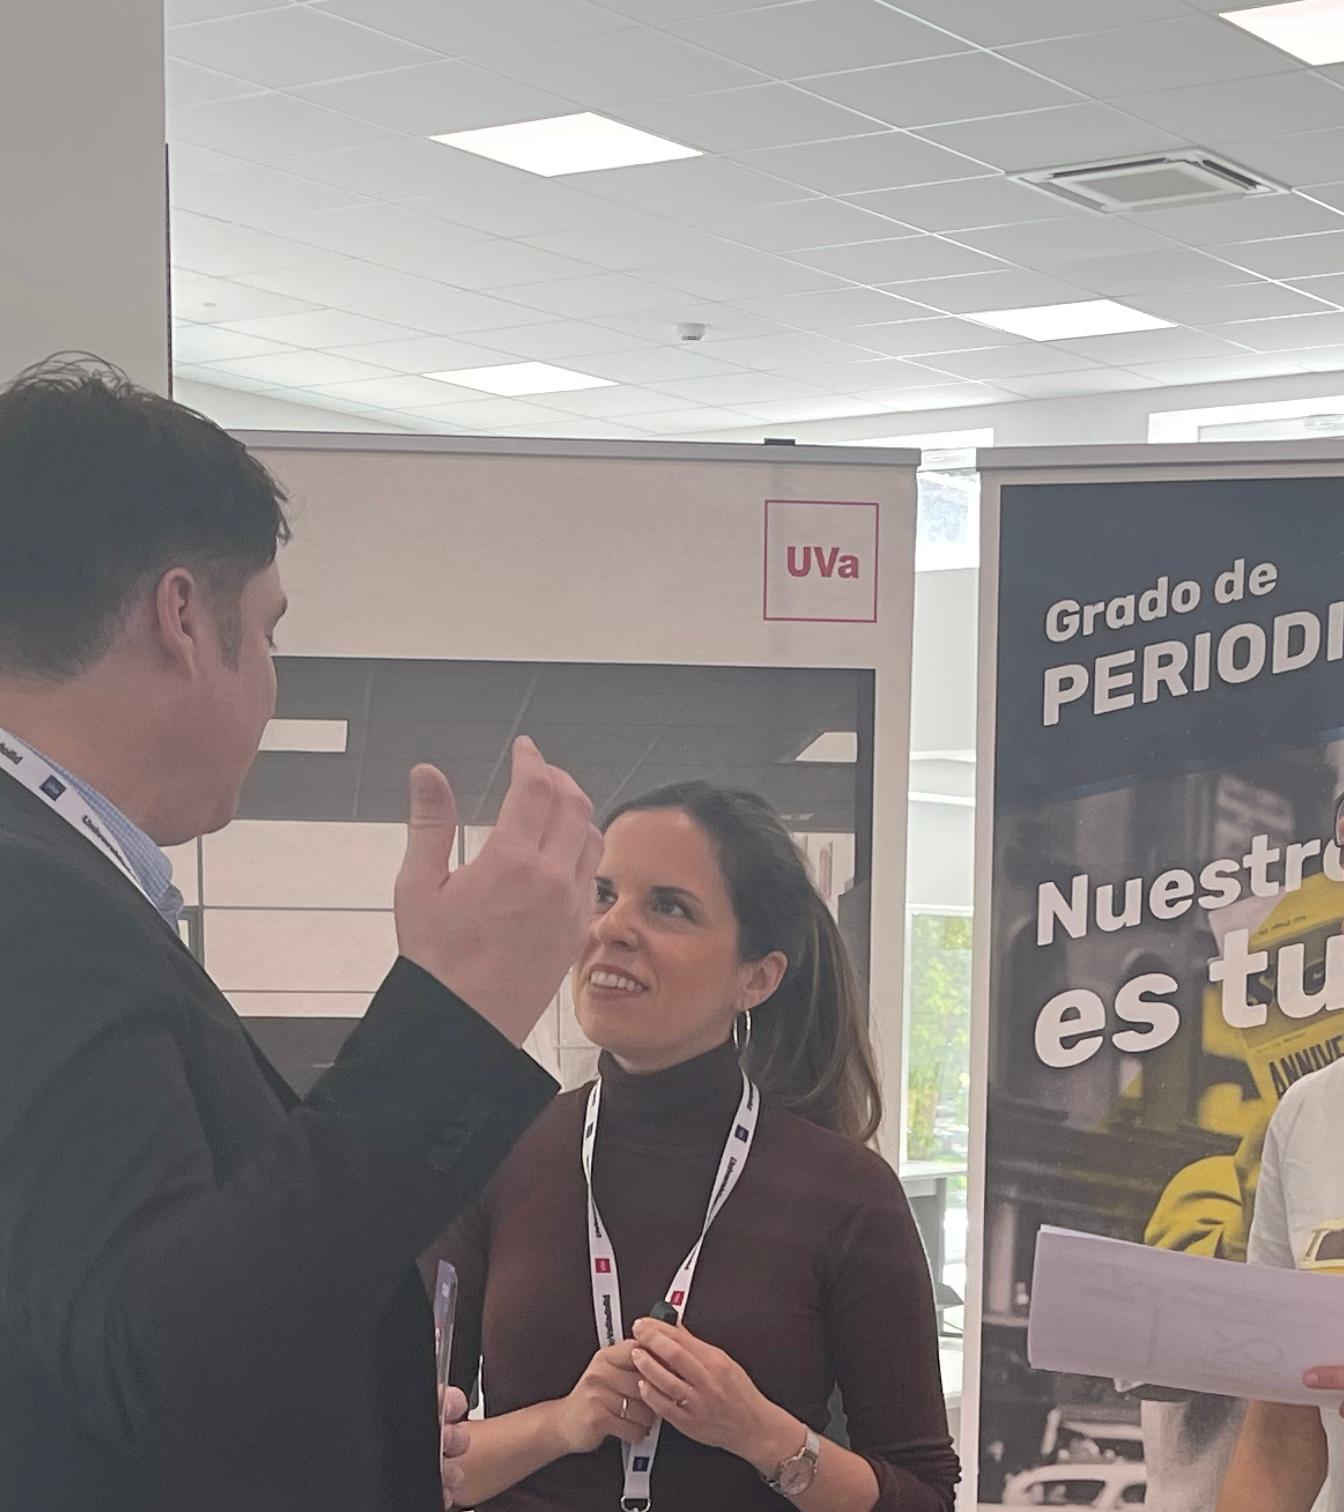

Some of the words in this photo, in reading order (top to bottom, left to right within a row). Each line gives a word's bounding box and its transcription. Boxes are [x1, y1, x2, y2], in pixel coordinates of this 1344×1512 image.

[787, 546, 859, 579] UVa
[1045, 576, 1201, 643] Grado
[1214, 558, 1278, 604] de
[1035, 973, 1180, 1068] es
